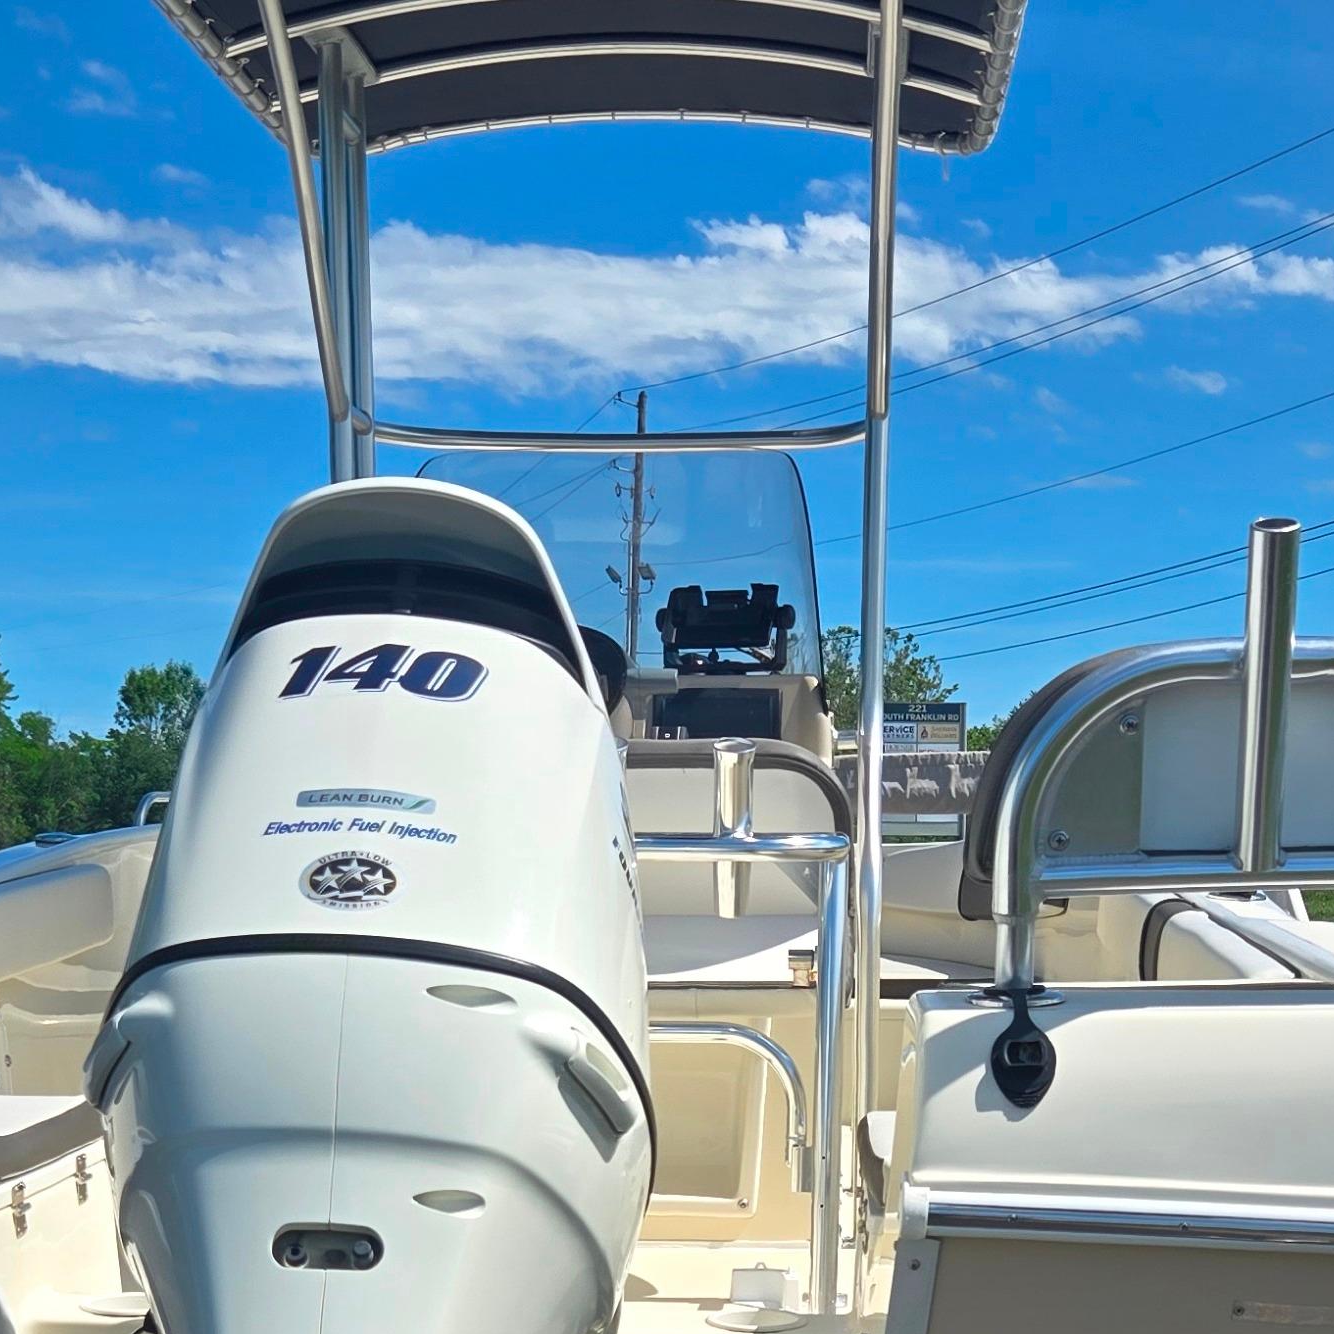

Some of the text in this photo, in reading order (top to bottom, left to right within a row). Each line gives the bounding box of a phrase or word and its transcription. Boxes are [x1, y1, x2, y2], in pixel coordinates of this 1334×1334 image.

[278, 643, 490, 702] 140
[908, 704, 927, 713] 221
[883, 713, 959, 721] OUTH FRANKLIN RD
[307, 793, 405, 806] LEAN BURN
[263, 818, 458, 844] Electronic Fuel Injection
